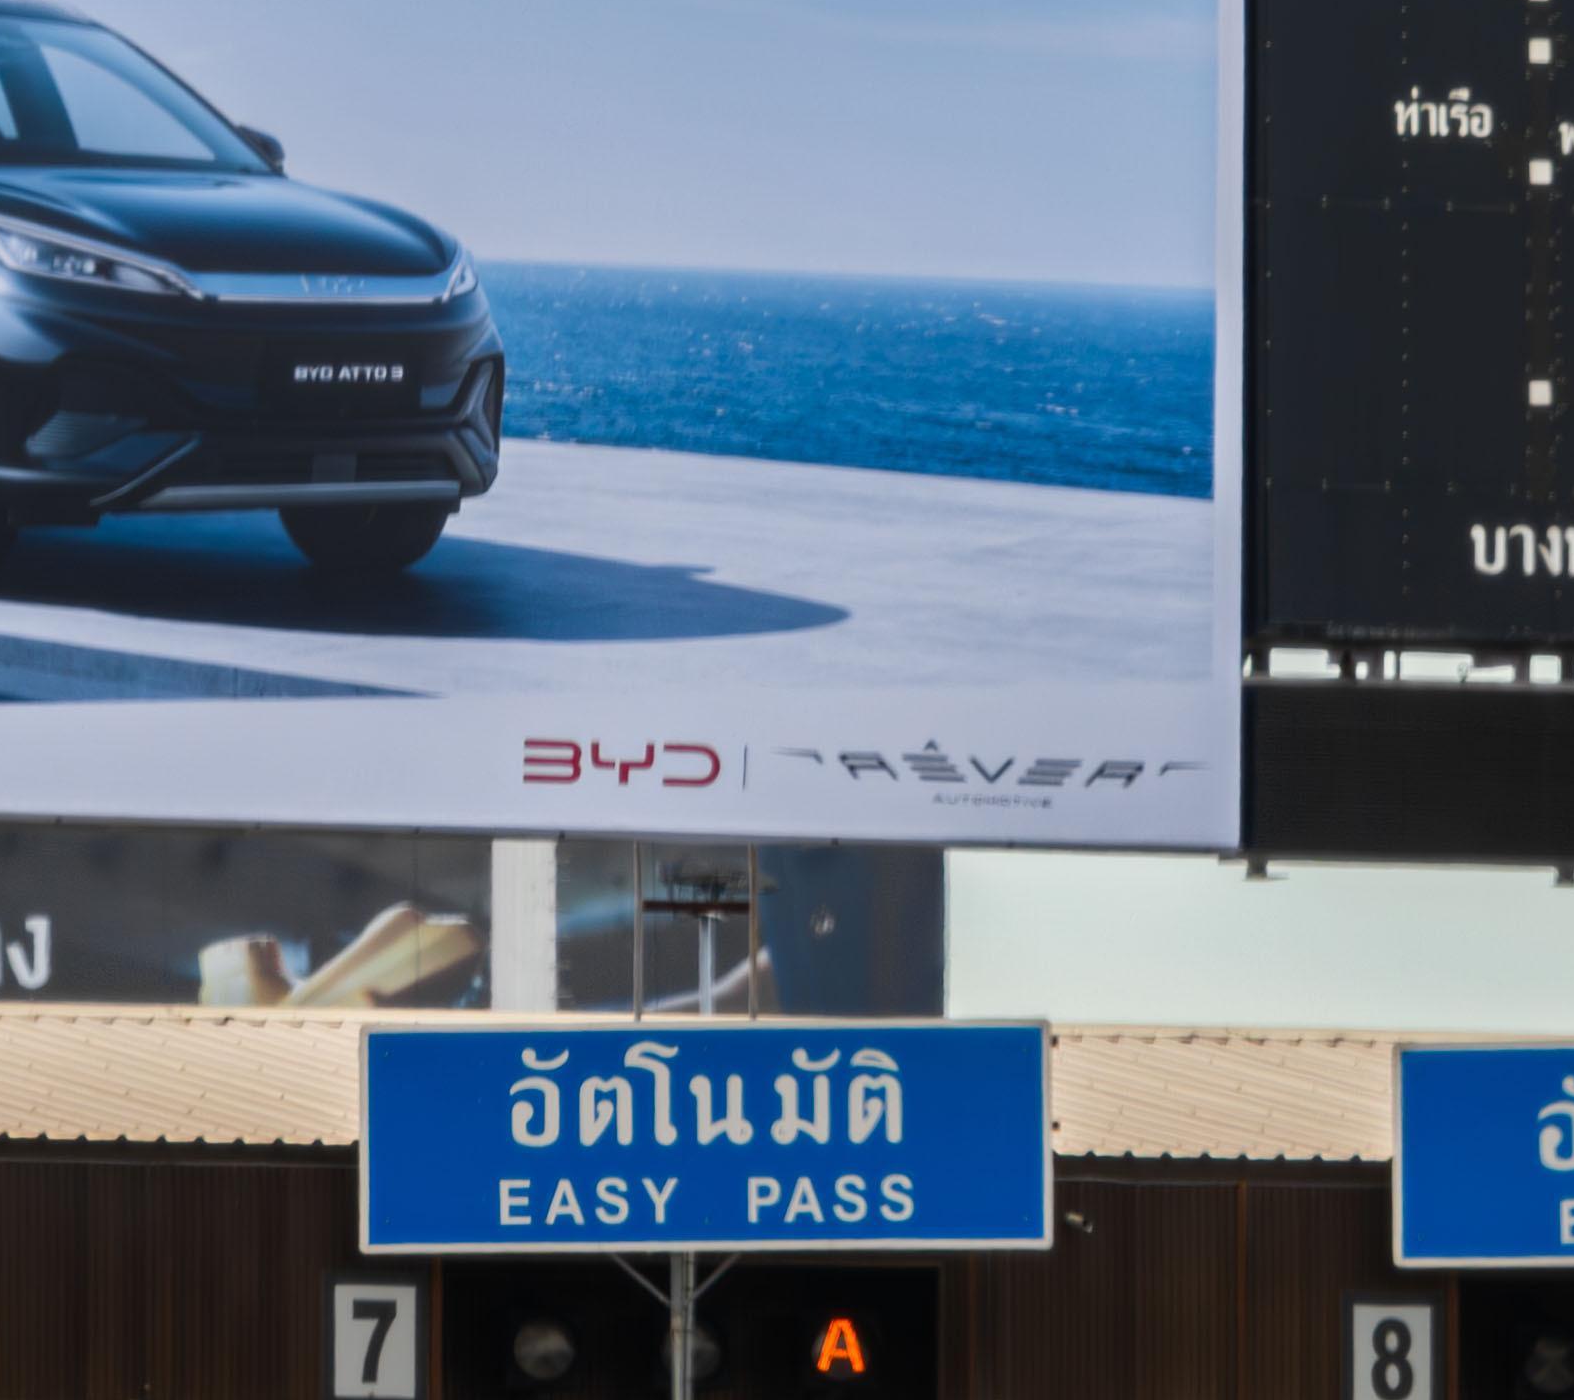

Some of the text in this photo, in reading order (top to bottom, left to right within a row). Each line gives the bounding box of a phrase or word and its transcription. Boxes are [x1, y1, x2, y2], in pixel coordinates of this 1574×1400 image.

[1394, 86, 1493, 138] ท่าเรือ
[294, 365, 334, 381] BYD
[338, 366, 387, 381] ATTO
[524, 739, 721, 787] BYD
[932, 793, 1053, 809] AUTOMOTIVE
[509, 1043, 905, 1148] อัตโนมัติ
[499, 1174, 916, 1227] EASY PASS
[353, 1301, 397, 1383] 7
[817, 1317, 866, 1373] A
